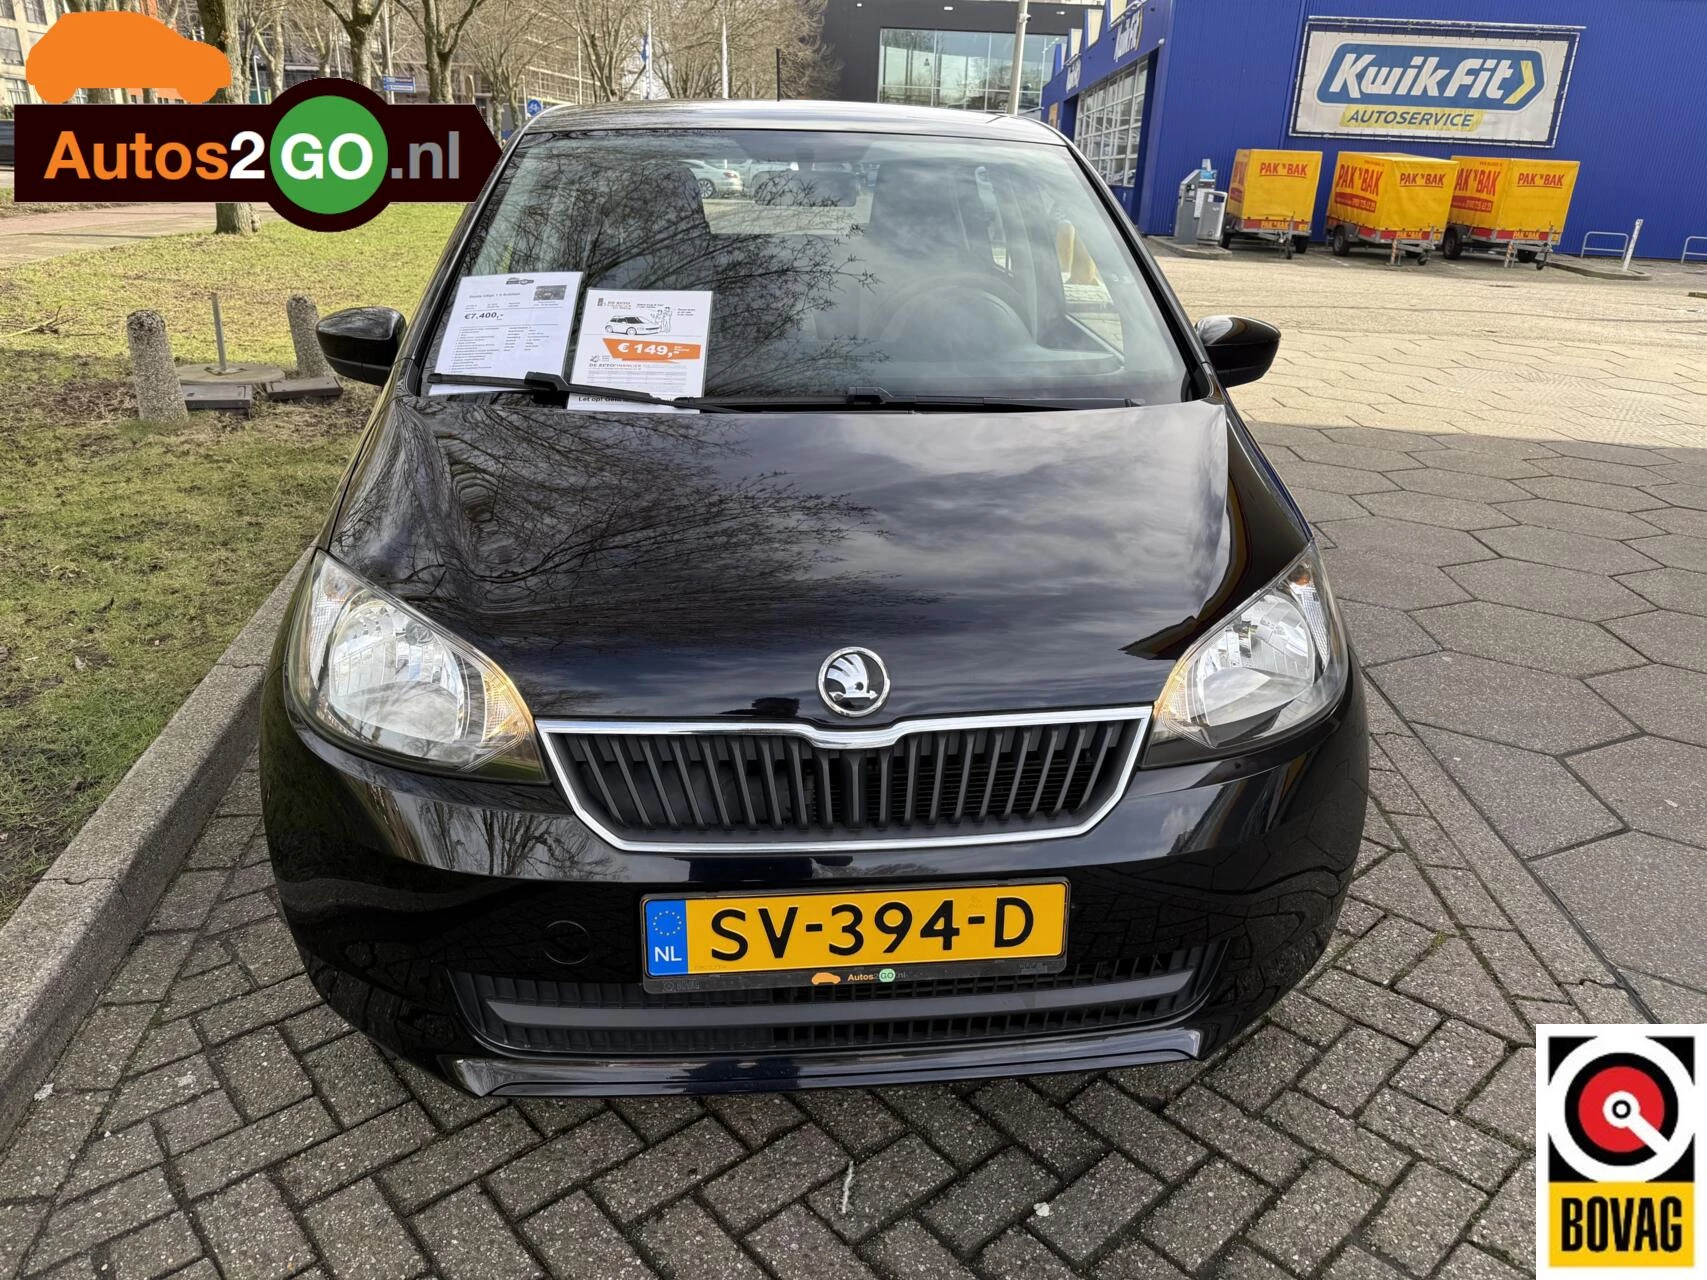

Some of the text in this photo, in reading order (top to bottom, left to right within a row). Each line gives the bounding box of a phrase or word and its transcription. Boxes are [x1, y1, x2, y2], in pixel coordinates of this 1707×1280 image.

[1329, 53, 1514, 99] KwikFit
[1347, 110, 1474, 127] AUTOSERVICE
[1259, 162, 1280, 175] PAK
[1286, 163, 1308, 176] BAK
[1336, 164, 1358, 190] PAK
[1360, 167, 1384, 196] BAK
[1400, 172, 1418, 185] PAK
[1424, 173, 1446, 186] BAK
[1455, 168, 1473, 192] AK
[1476, 170, 1501, 196] BAK
[1518, 173, 1538, 185] PAK
[1543, 174, 1565, 186] BAK
[710, 897, 1034, 961] SV-394-D
[654, 946, 682, 962] NL
